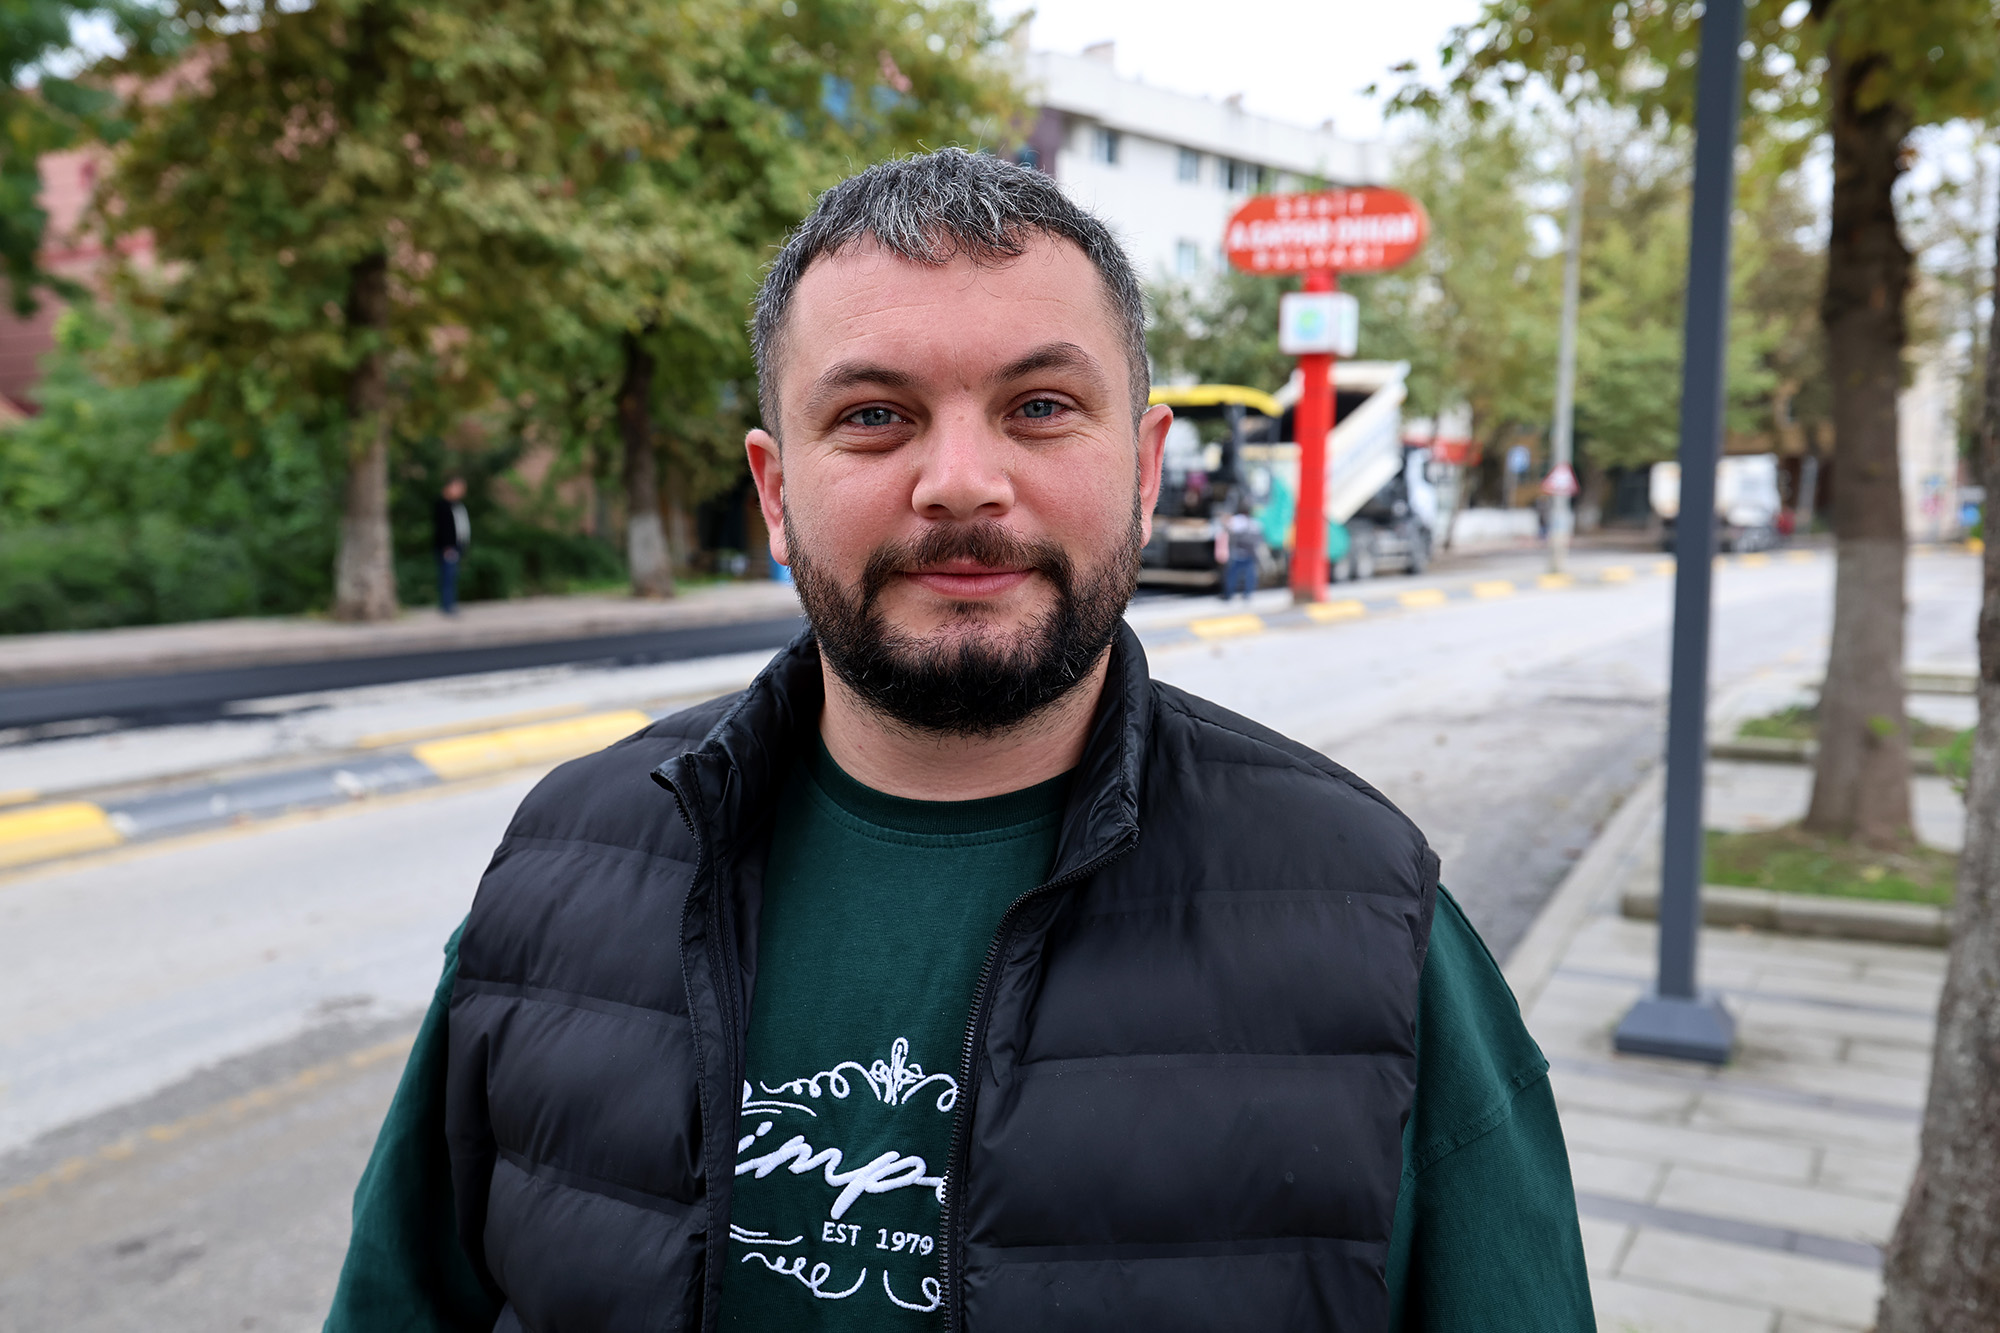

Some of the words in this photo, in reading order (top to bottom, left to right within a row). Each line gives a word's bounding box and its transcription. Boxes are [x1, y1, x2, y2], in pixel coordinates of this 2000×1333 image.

[735, 1121, 948, 1220] imp
[822, 1221, 861, 1246] EST
[876, 1228, 934, 1255] 1979
